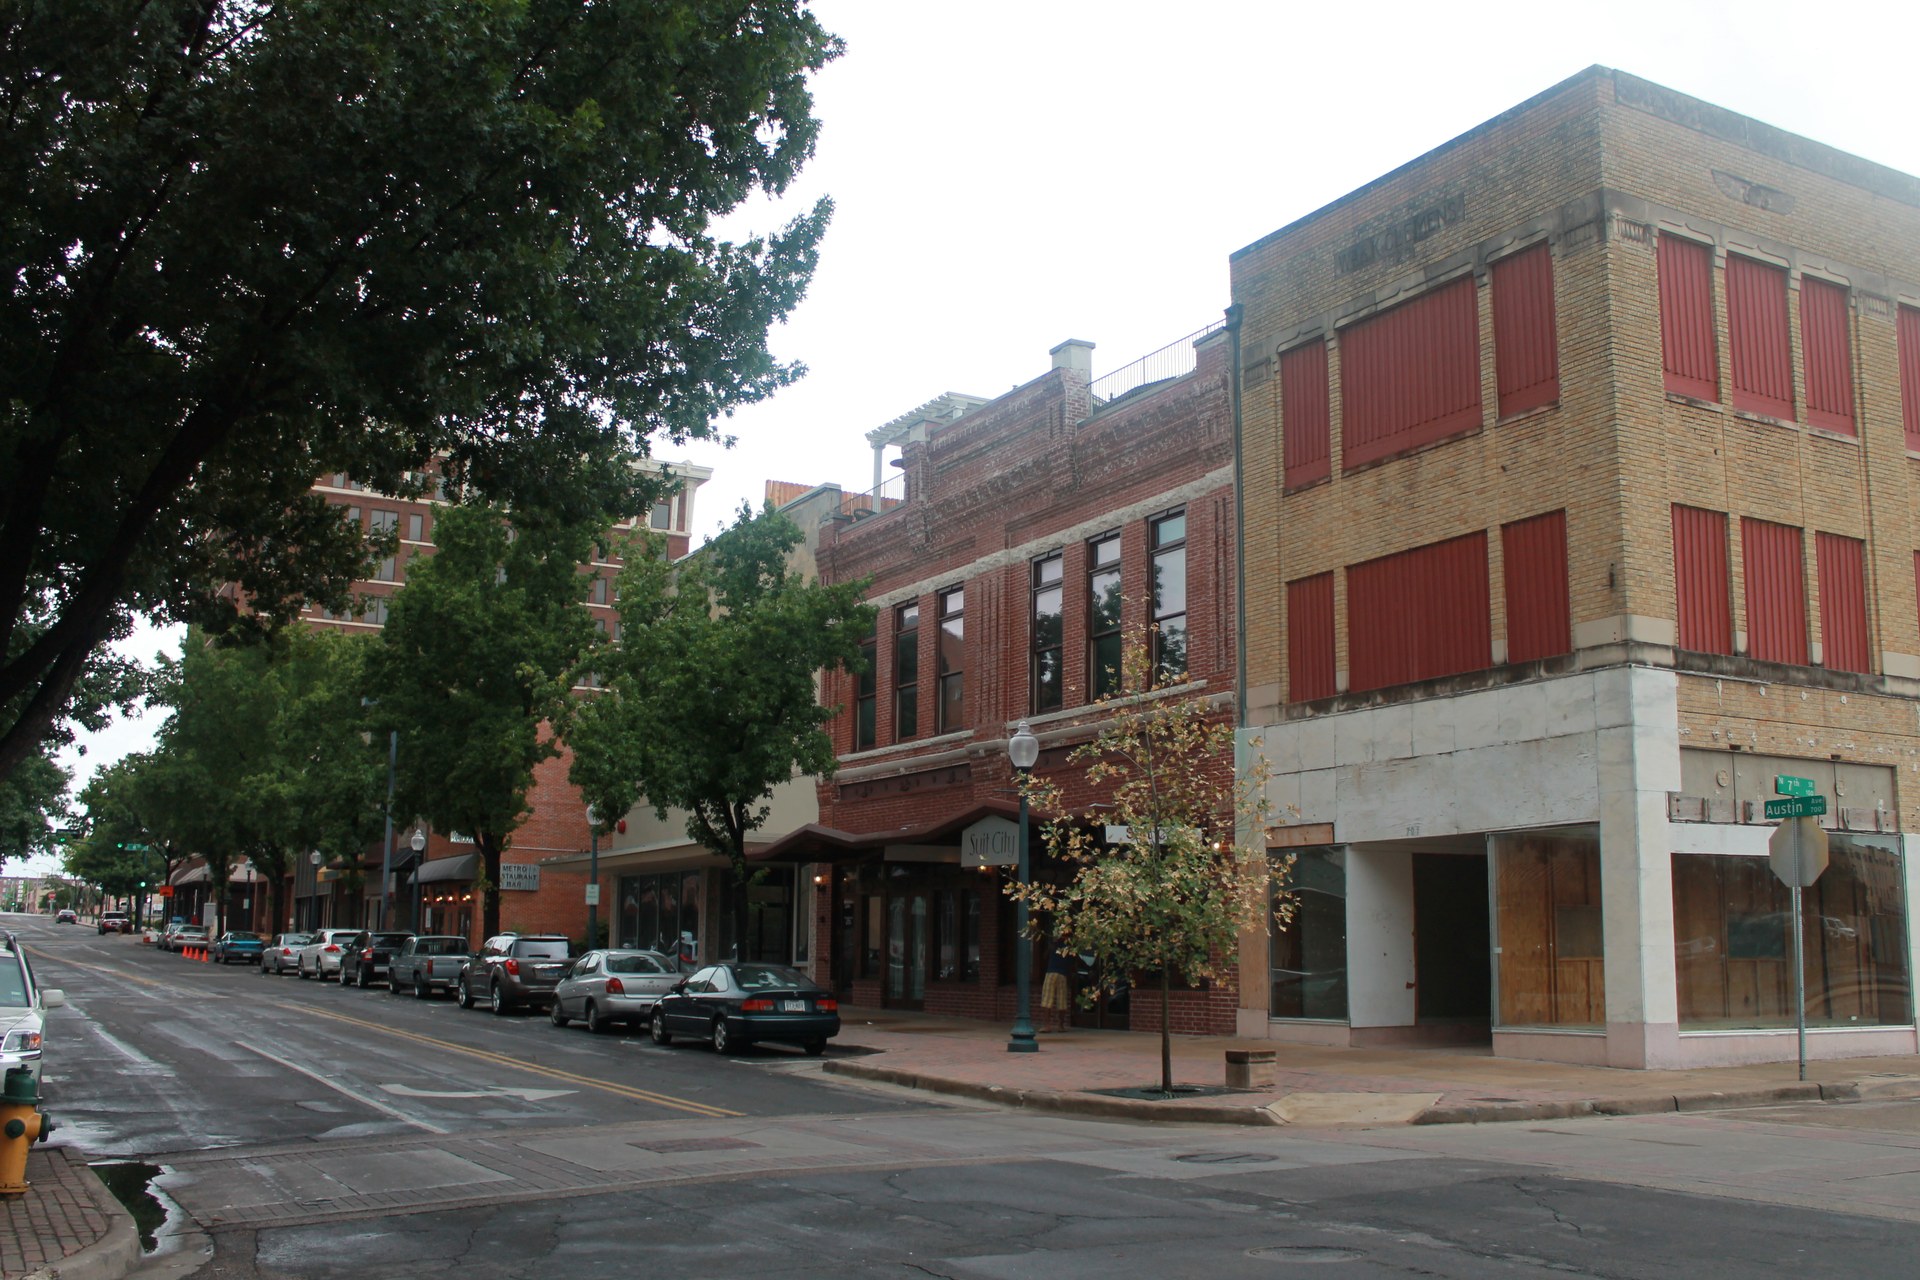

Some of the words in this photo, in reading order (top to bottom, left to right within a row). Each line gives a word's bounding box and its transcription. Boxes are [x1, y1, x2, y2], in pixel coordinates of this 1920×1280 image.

[1778, 776, 1784, 785] N
[1787, 777, 1800, 791] 7th
[1766, 802, 1803, 816] Austin
[969, 833, 989, 856] Suit
[992, 831, 1016, 857] City
